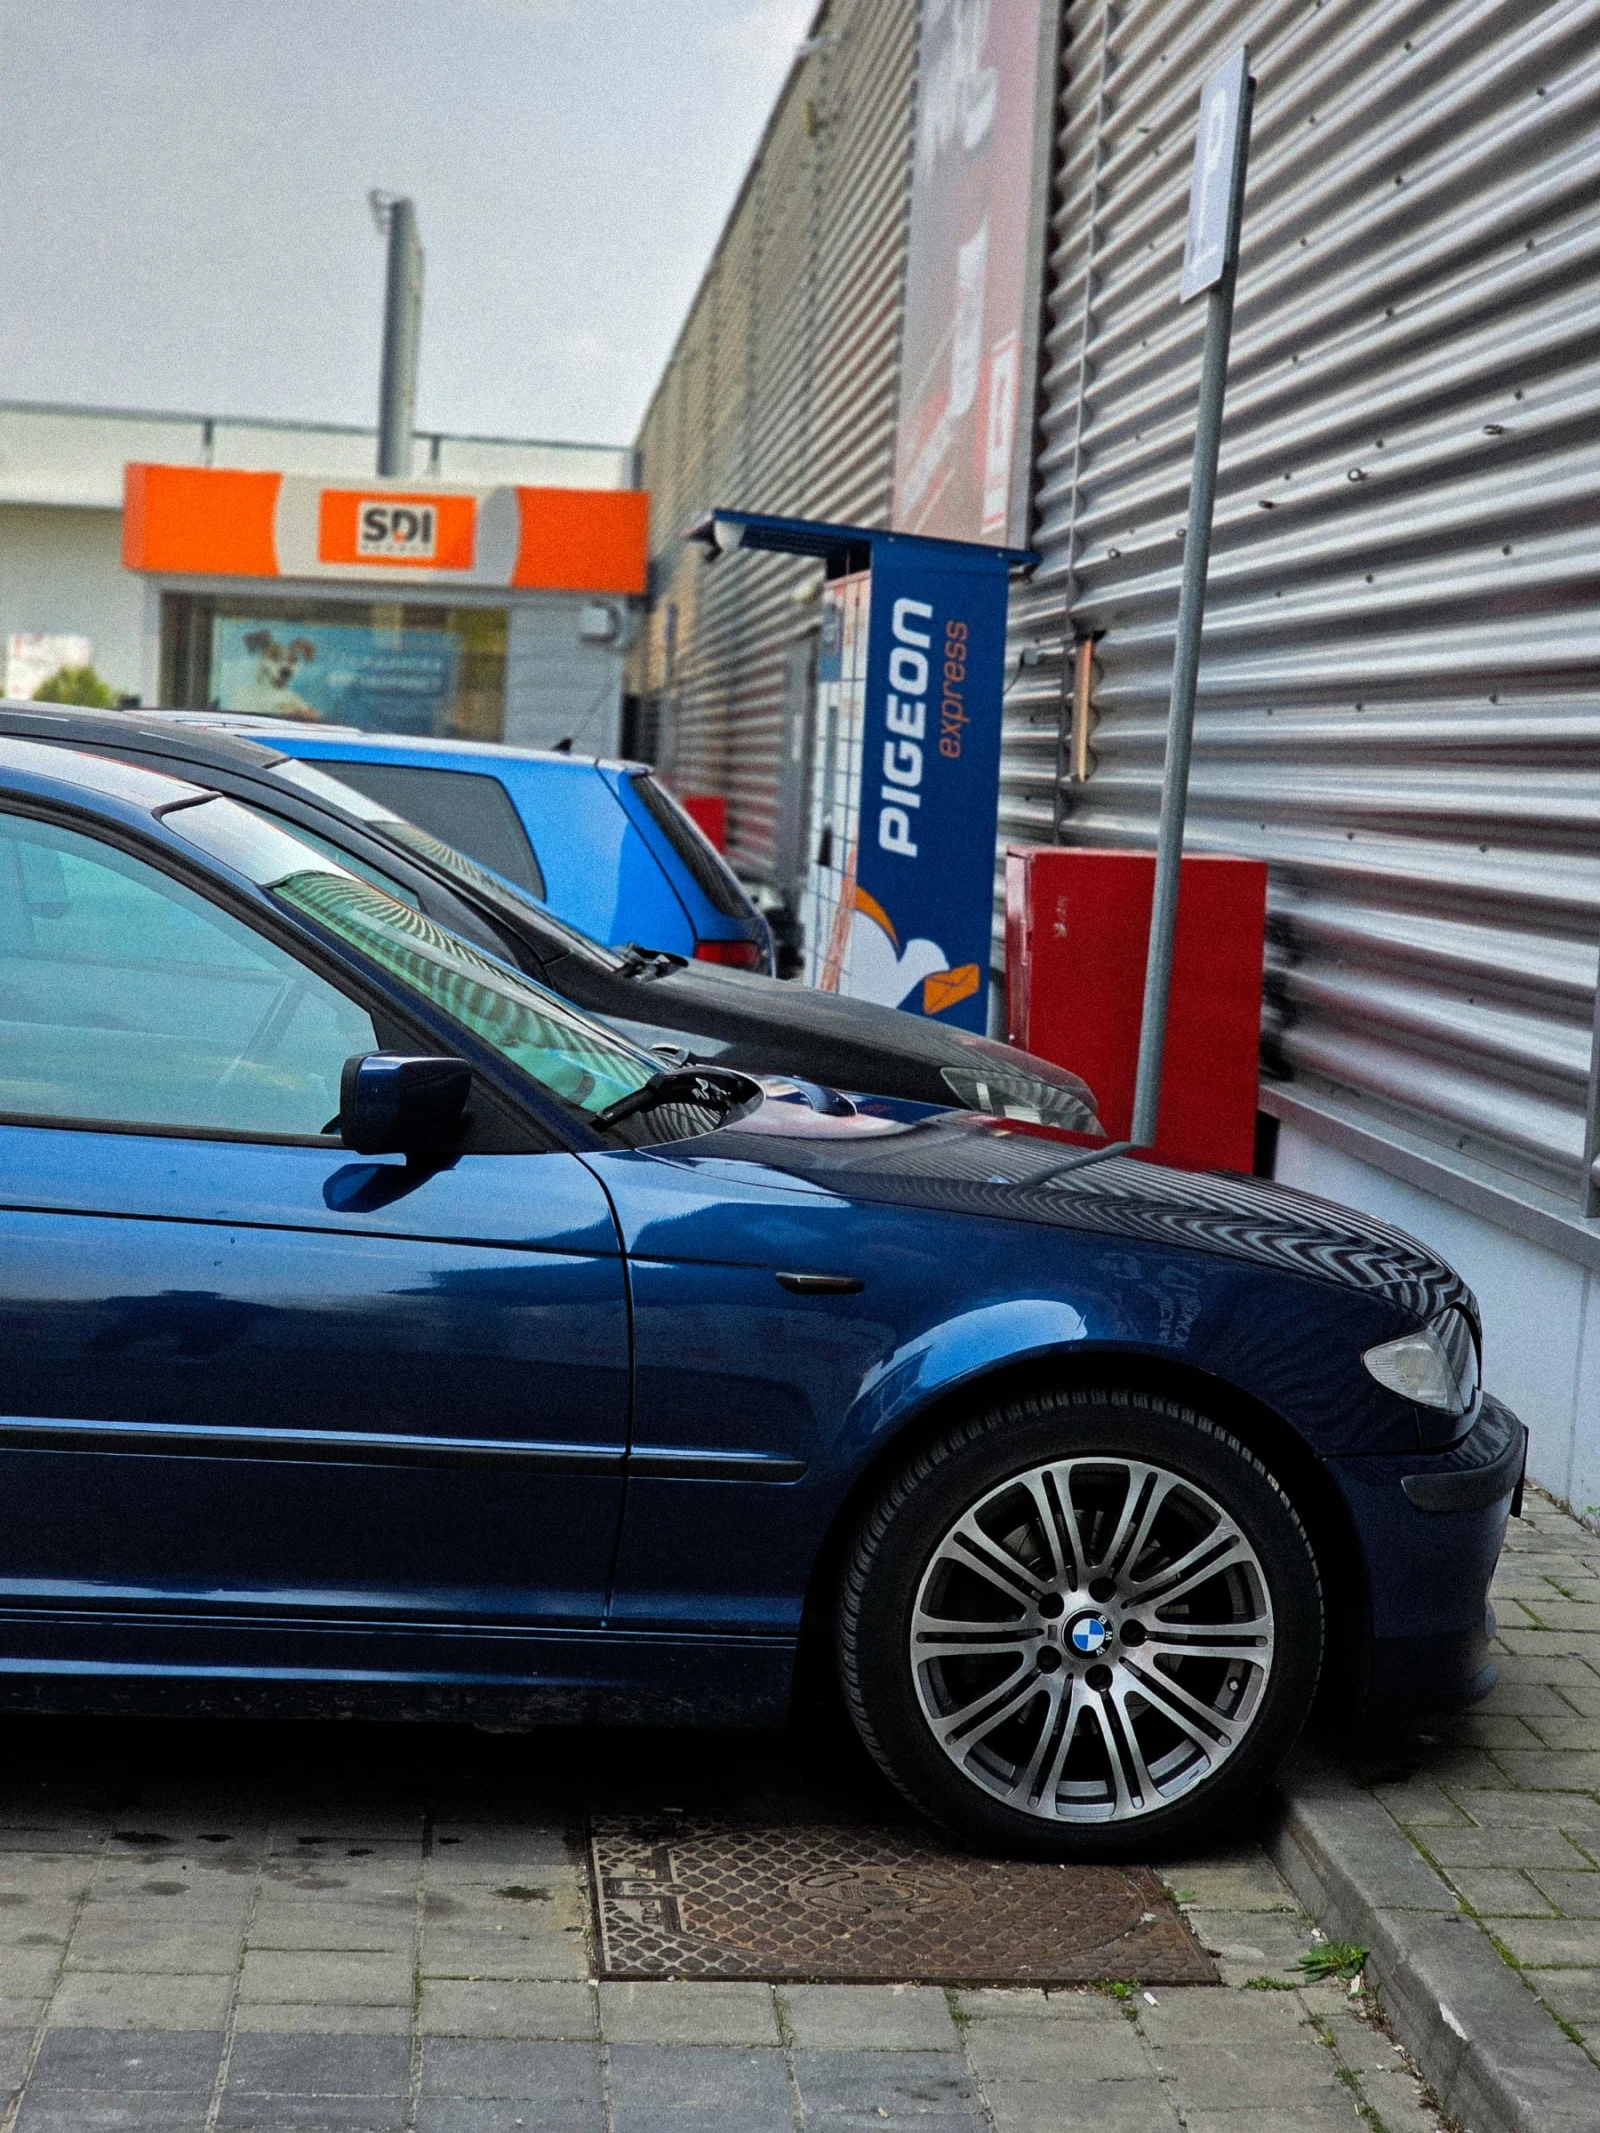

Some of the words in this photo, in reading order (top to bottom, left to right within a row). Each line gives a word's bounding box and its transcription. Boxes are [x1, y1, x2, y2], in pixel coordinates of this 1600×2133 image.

[364, 508, 431, 543] SDI
[878, 597, 933, 858] PIGEON
[938, 619, 970, 759] express
[1096, 1614, 1113, 1657] BMW
